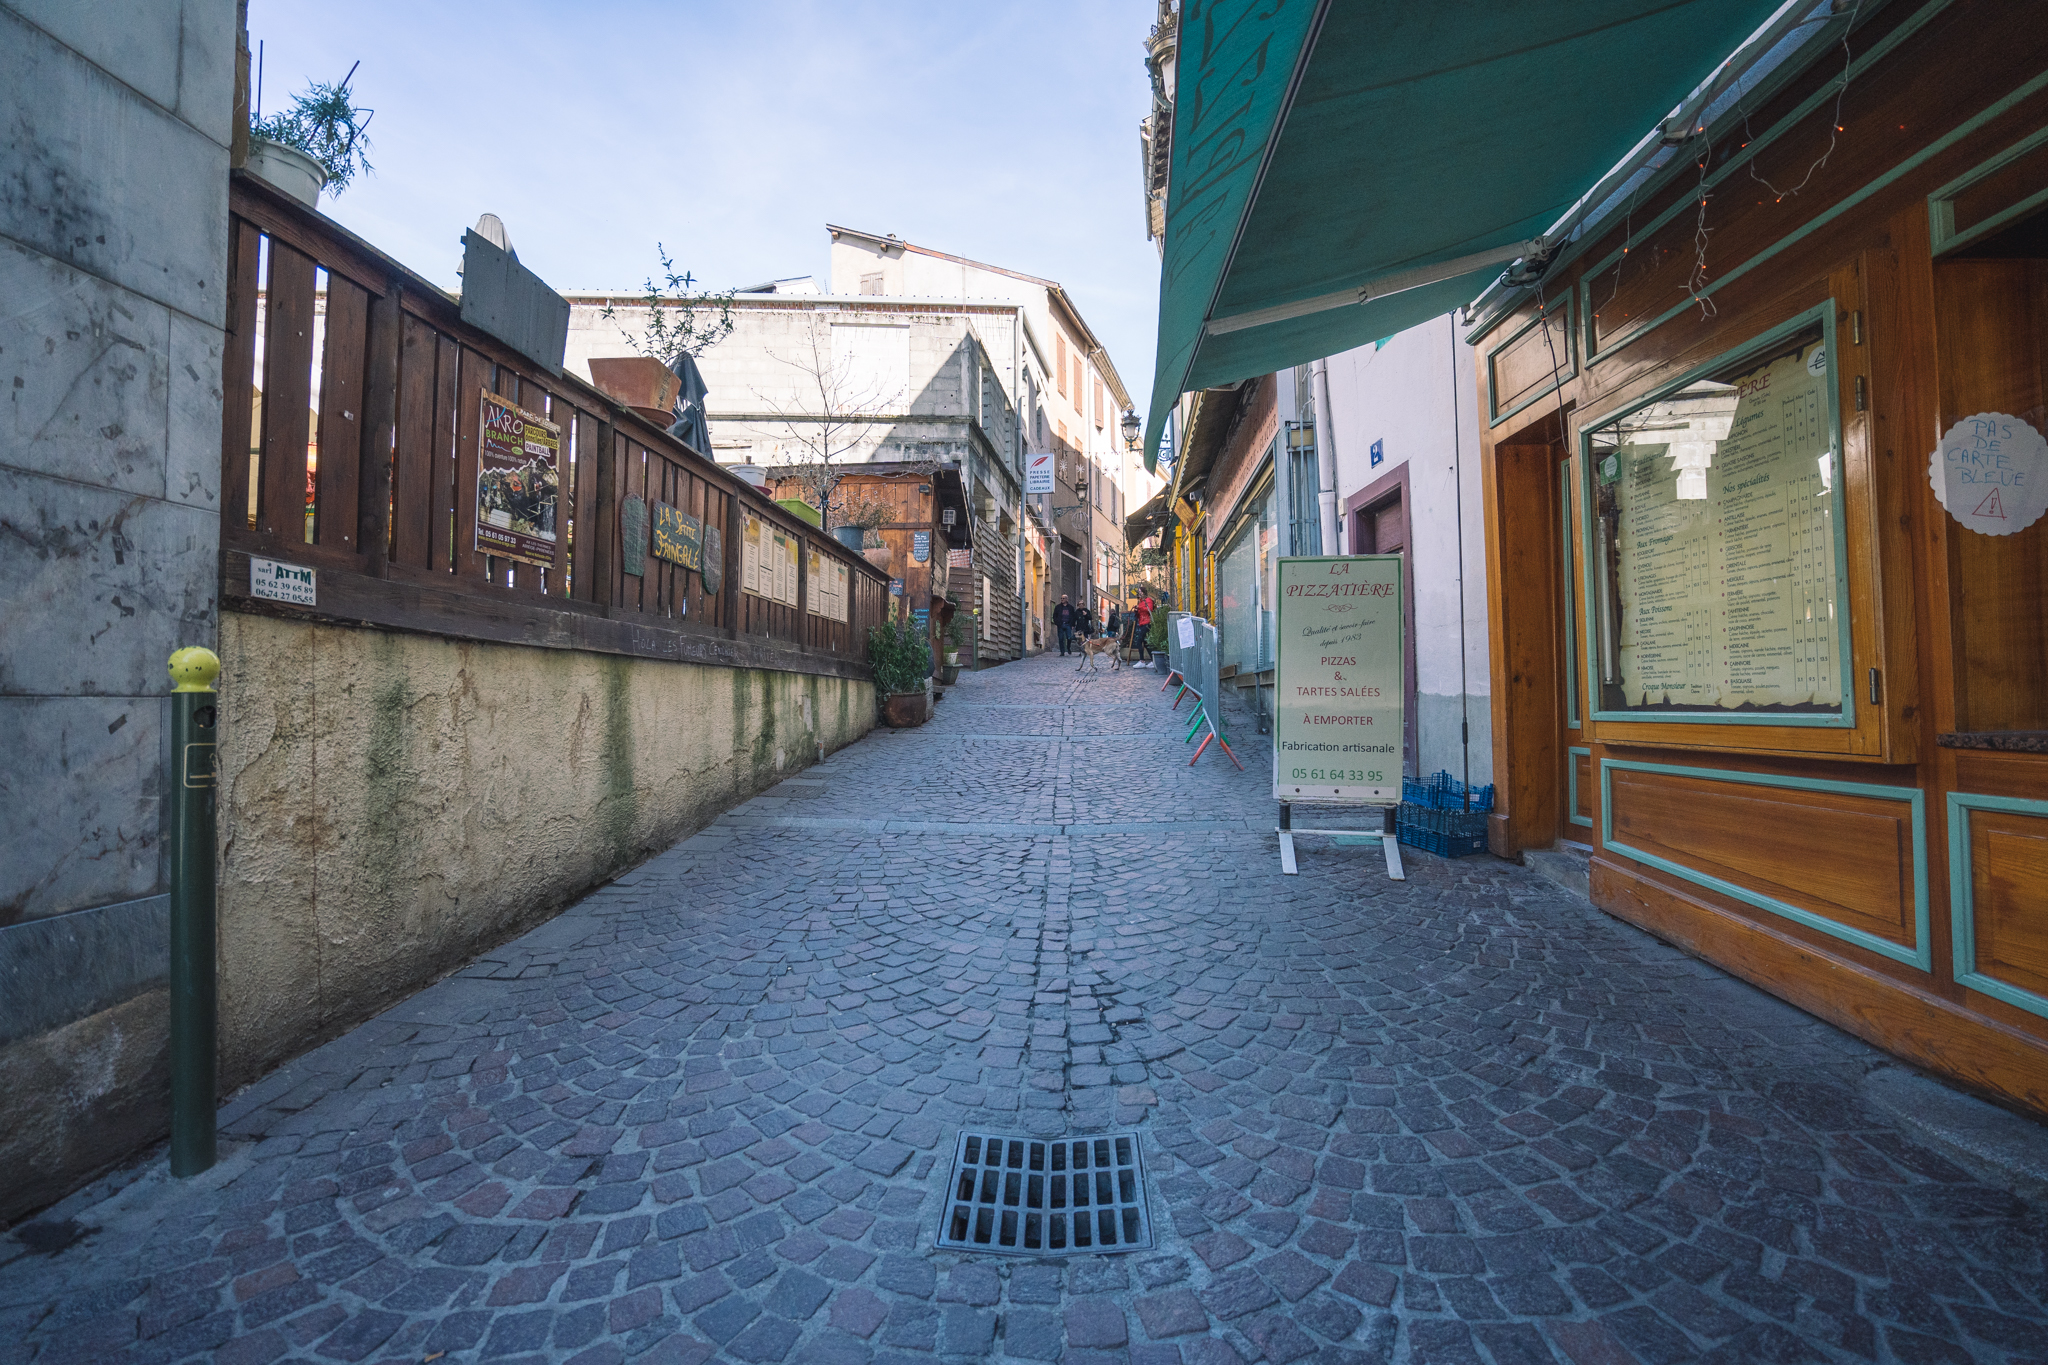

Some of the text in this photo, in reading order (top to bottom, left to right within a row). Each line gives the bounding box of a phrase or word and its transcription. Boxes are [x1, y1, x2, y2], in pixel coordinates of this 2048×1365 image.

[1735, 411, 1764, 429] Légumes
[525, 425, 547, 438] PARCOURS
[1969, 420, 2012, 439] PAS
[486, 429, 524, 446] BRANCH
[1972, 434, 2002, 451] DE
[525, 442, 550, 456] PAINTBALL
[1947, 448, 2013, 471] CARTE
[1954, 466, 2025, 486] BLEUE
[1722, 473, 1770, 494] Nos spécialités
[275, 565, 312, 586] ATTM
[1329, 563, 1350, 576] LA
[256, 578, 266, 587] 05
[1286, 580, 1395, 598] PIZZATIÈRE
[1302, 626, 1331, 637] Qualité
[1339, 619, 1376, 630] savoir-faire
[1320, 633, 1362, 648] depuis 1983
[1321, 657, 1356, 665] PIZZAS
[1334, 671, 1342, 680] &
[1296, 686, 1380, 696] TARTES SALÉES
[1642, 683, 1659, 693] Croque
[1303, 713, 1373, 725] À EMPORTER
[1282, 741, 1395, 753] Fabrication artisanale
[1292, 768, 1383, 781] 05 61 64 33 95
